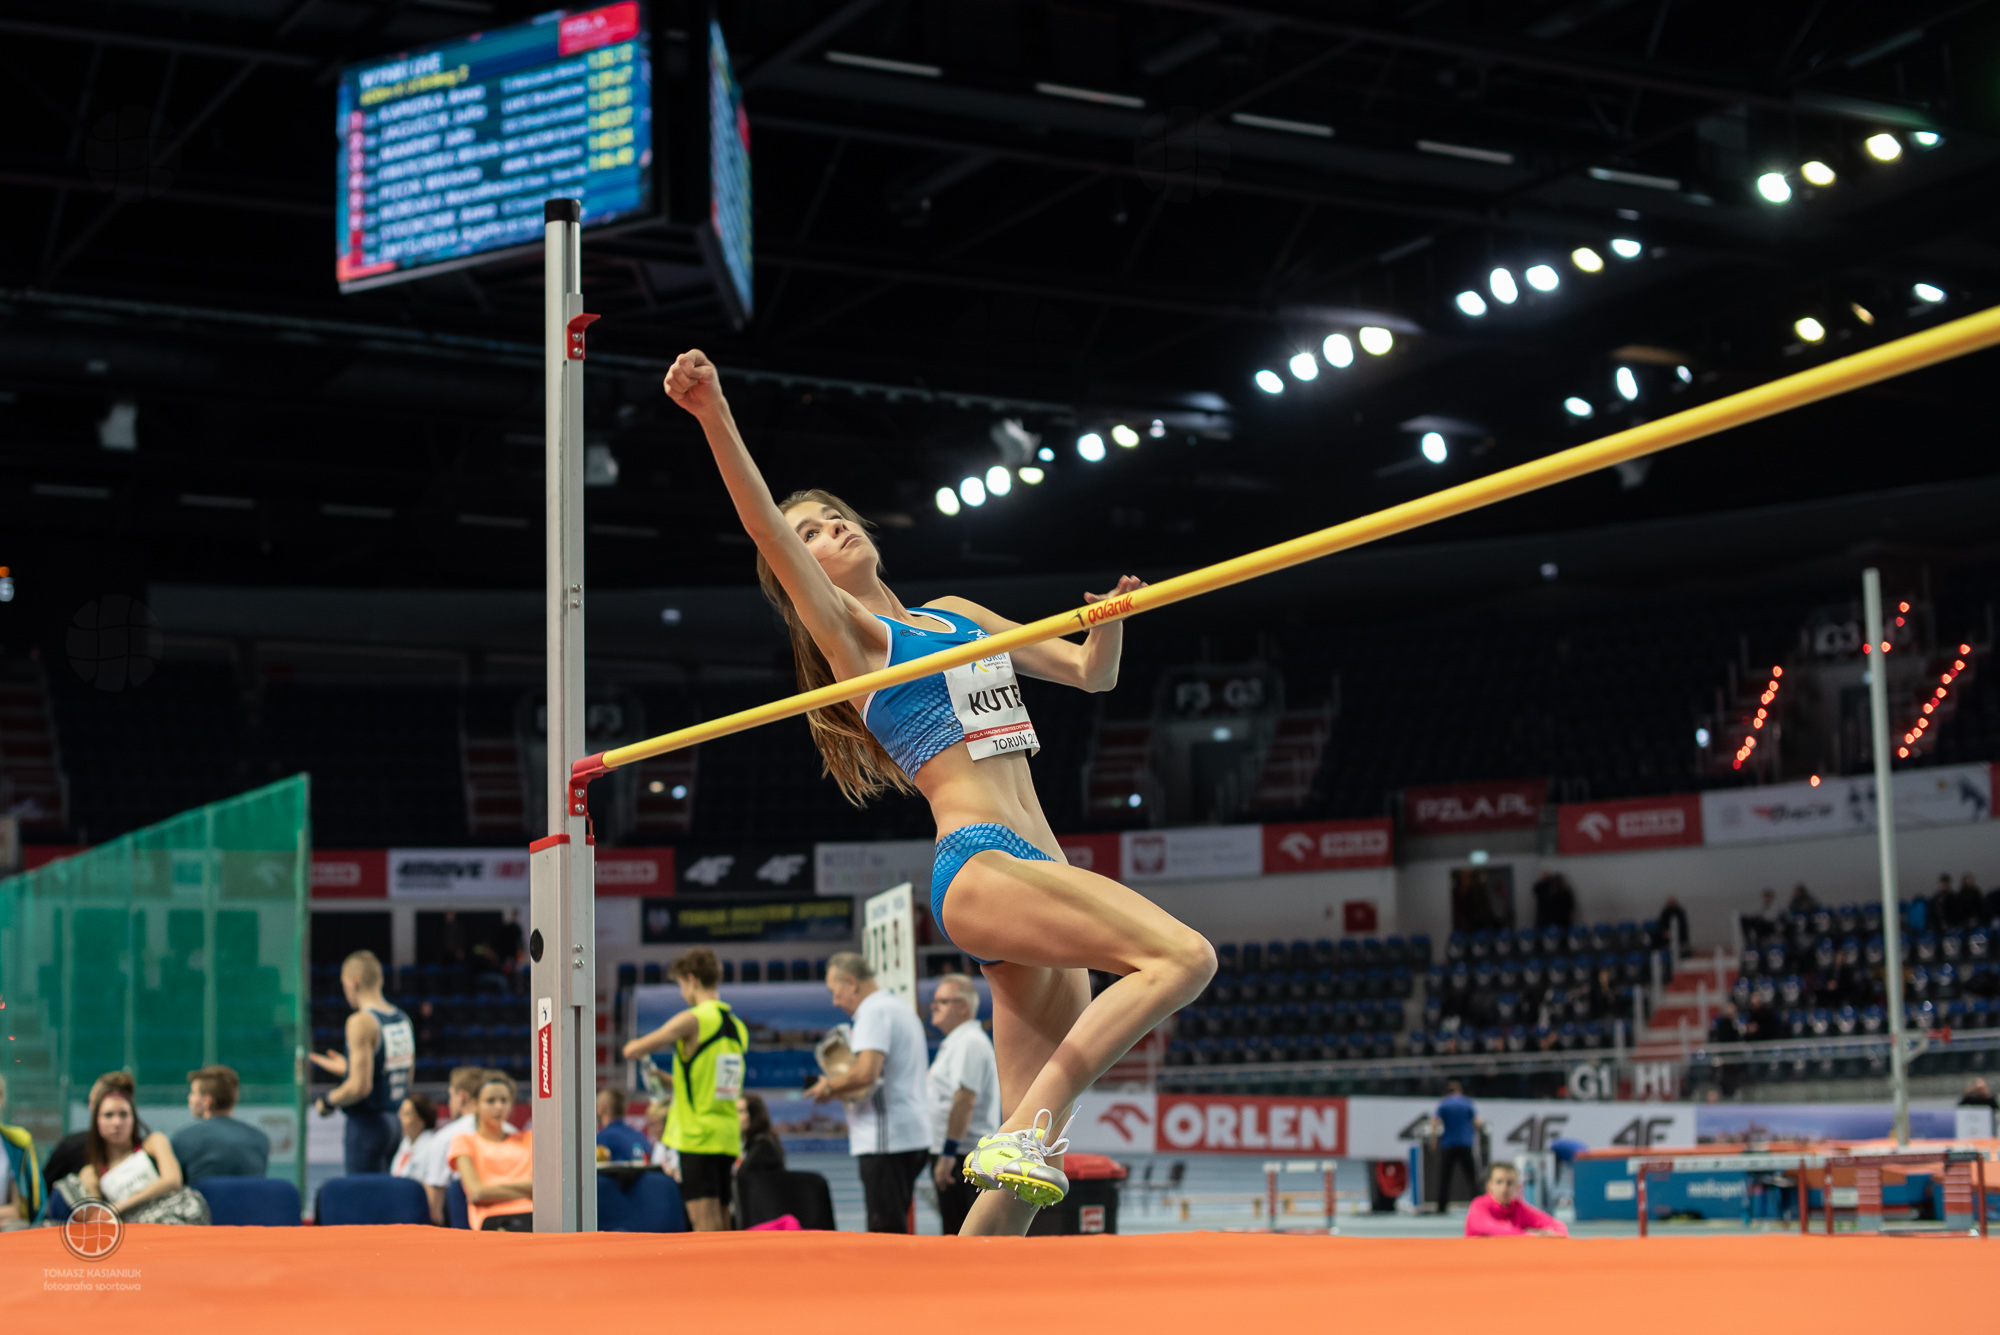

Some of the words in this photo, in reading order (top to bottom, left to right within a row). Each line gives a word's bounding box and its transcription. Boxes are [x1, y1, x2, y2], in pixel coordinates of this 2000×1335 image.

[1087, 594, 1135, 626] polanik
[993, 731, 1027, 751] TORUŃ
[541, 1031, 550, 1094] polanik
[1635, 1062, 1673, 1096] H1
[1570, 1064, 1611, 1099] G1
[1162, 1102, 1338, 1151] ORLEN
